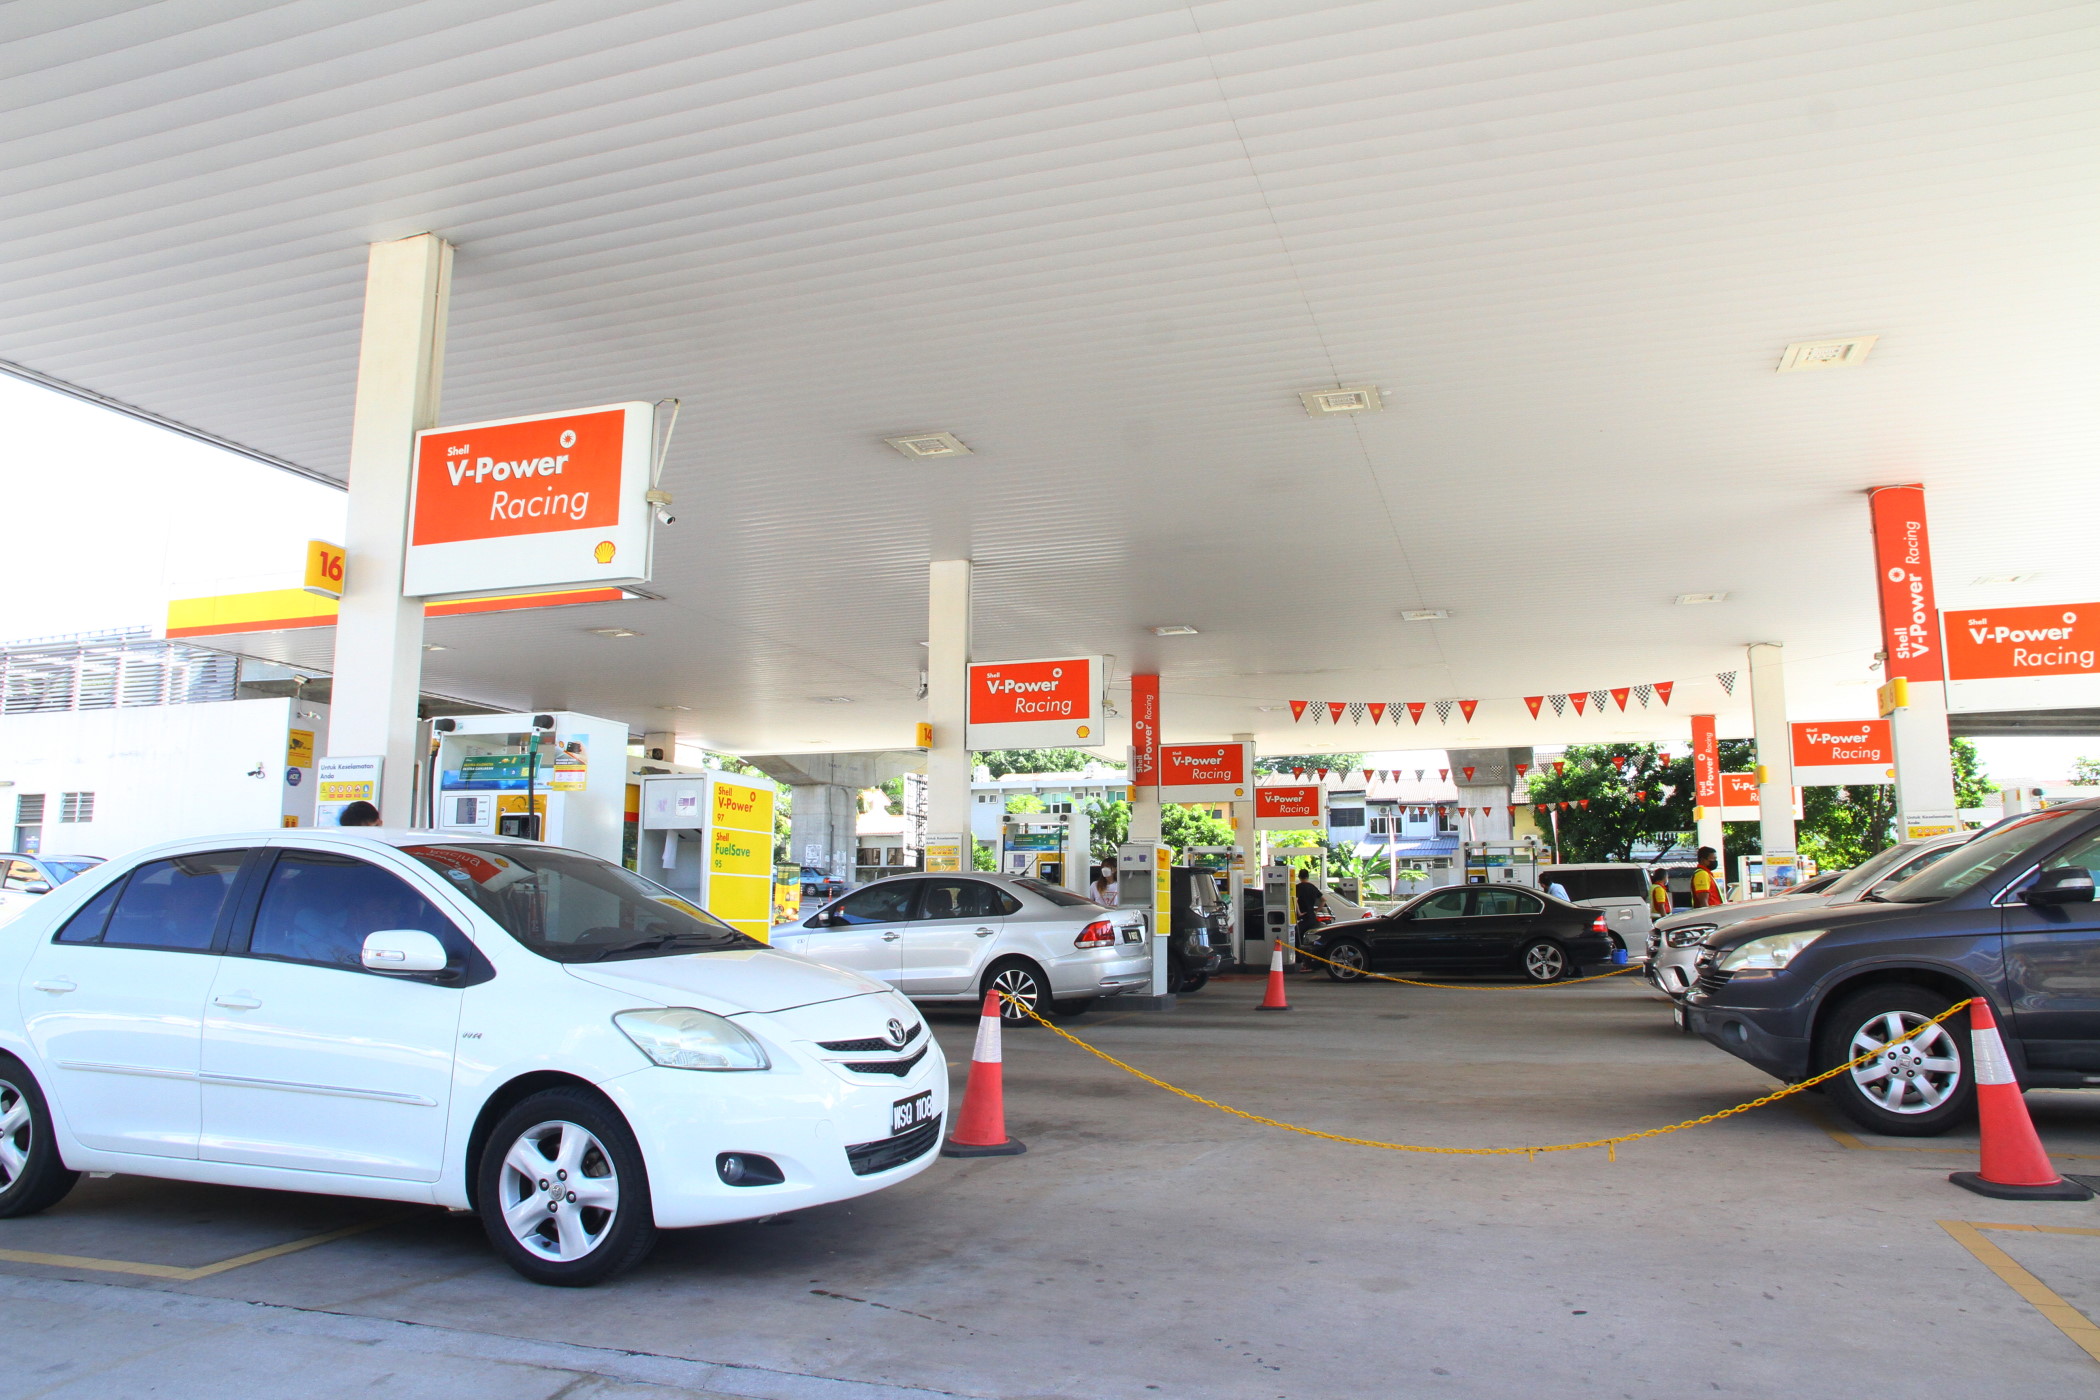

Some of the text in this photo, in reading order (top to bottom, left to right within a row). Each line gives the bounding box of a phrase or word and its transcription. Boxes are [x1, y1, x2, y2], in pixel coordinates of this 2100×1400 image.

[446, 444, 470, 457] Shell
[446, 454, 570, 487] V-Power
[489, 485, 590, 521] Racing
[319, 550, 343, 582] 16
[1903, 520, 1930, 659] V-Power Racing
[1967, 618, 1988, 626] Shell
[1894, 627, 1910, 660] Shell
[1968, 626, 2073, 645] V-Power
[2013, 646, 2095, 669] Racing
[986, 679, 1059, 695] V-Power
[1015, 696, 1072, 716] Racing
[923, 727, 933, 742] 14
[1143, 694, 1154, 773] V-Power Racing
[1806, 733, 1869, 745] V-Power
[1172, 756, 1223, 767] V-Power
[1831, 746, 1881, 761] Racing
[1136, 754, 1144, 773] Shell
[1705, 732, 1715, 796] V-Power Racing
[1192, 768, 1232, 781] Racing
[718, 786, 733, 796] Shell
[1264, 795, 1303, 803] V-Power
[718, 796, 753, 813] V-Power
[1280, 804, 1310, 815] Racing
[717, 813, 725, 823] 97
[716, 832, 730, 842] Shell
[715, 842, 751, 858] FuelSave
[714, 859, 723, 869] 95
[893, 1094, 933, 1130] WSQ 1108
